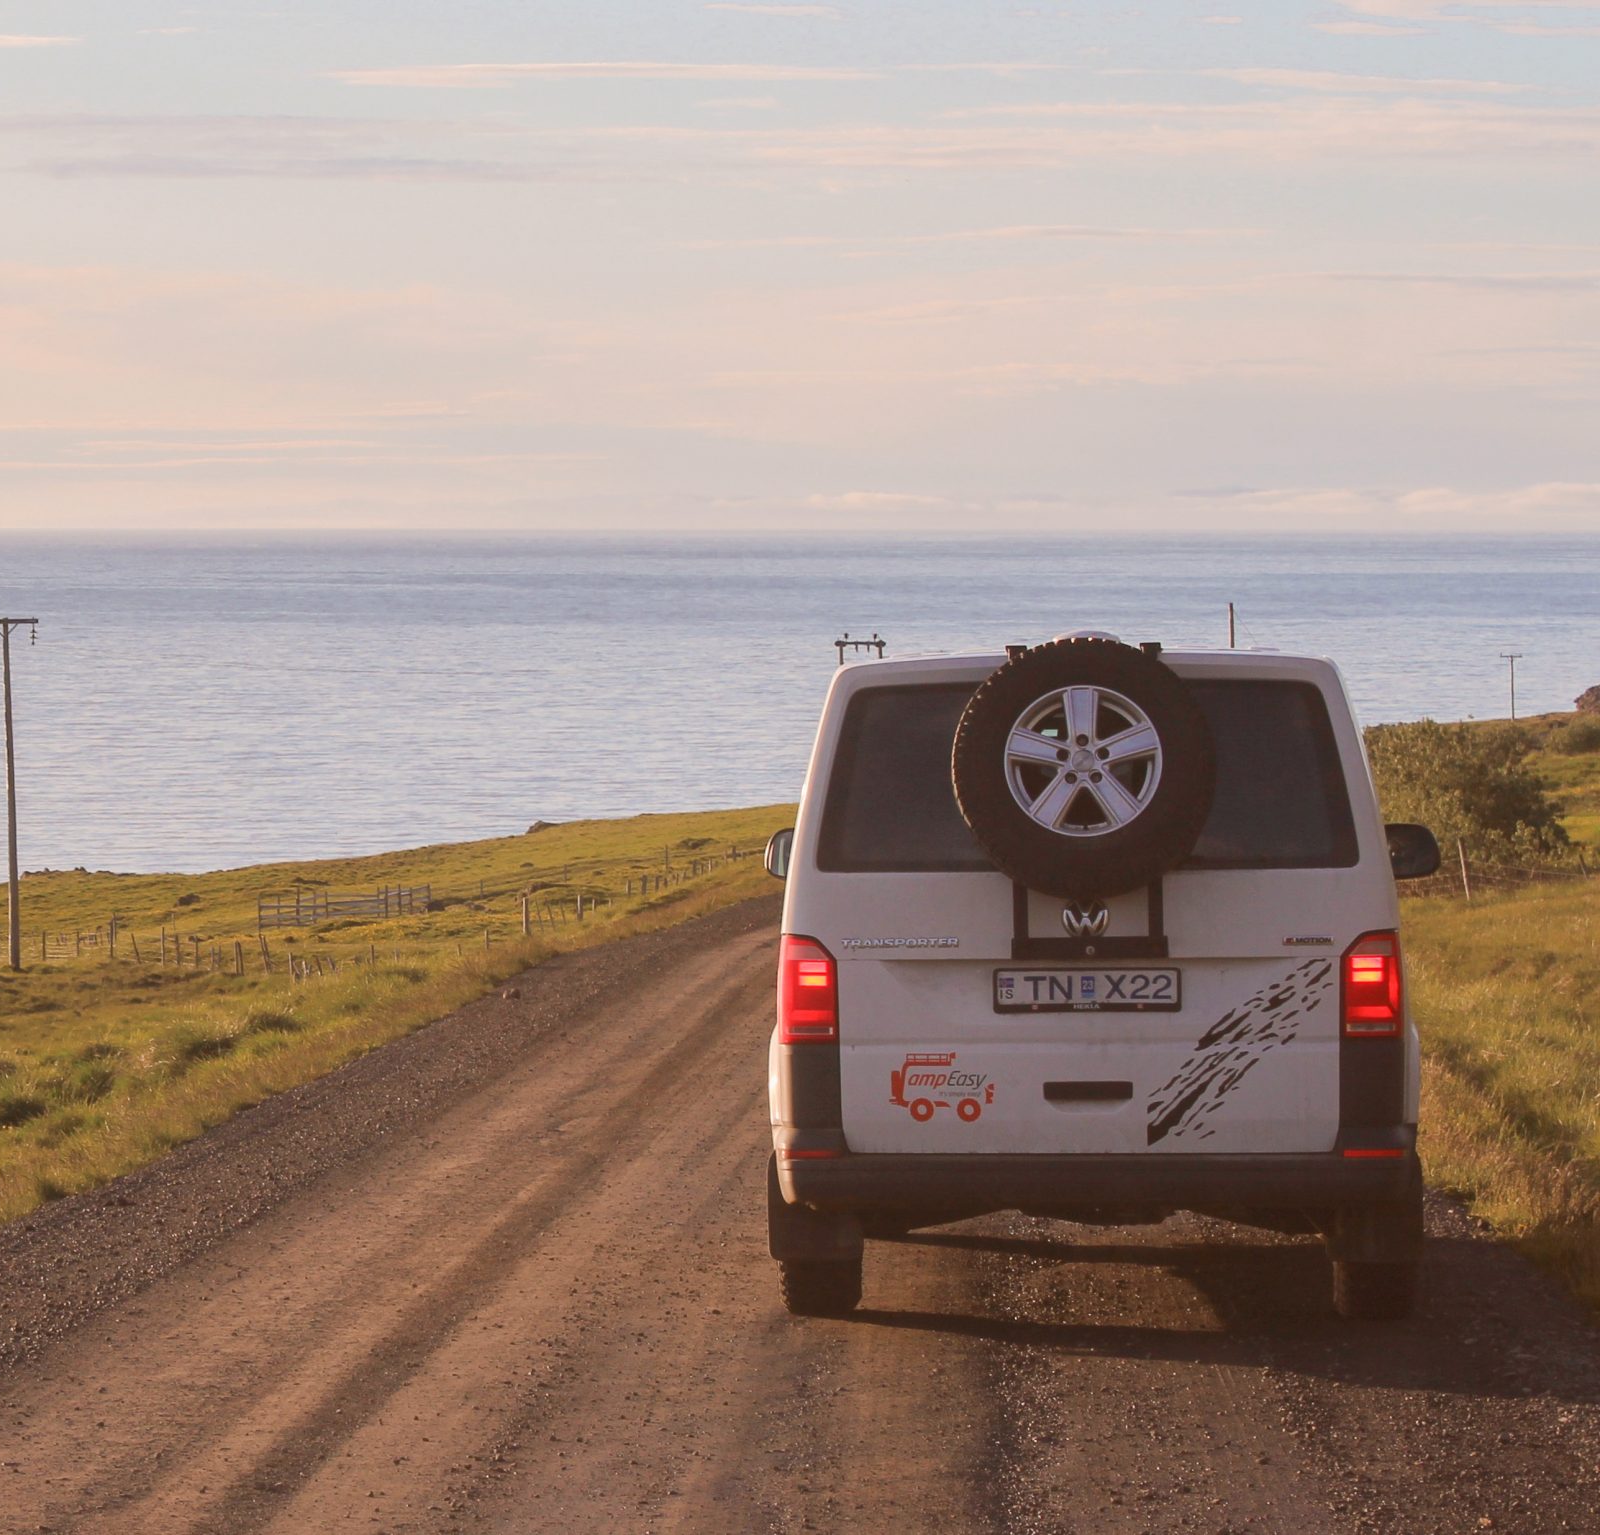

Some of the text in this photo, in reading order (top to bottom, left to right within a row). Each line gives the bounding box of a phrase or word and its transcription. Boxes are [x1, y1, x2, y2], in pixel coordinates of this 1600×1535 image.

[841, 937, 958, 948] TRANSPORTER
[1024, 974, 1172, 1000] TN X22
[1082, 980, 1094, 990] 23
[1000, 988, 1014, 999] IS
